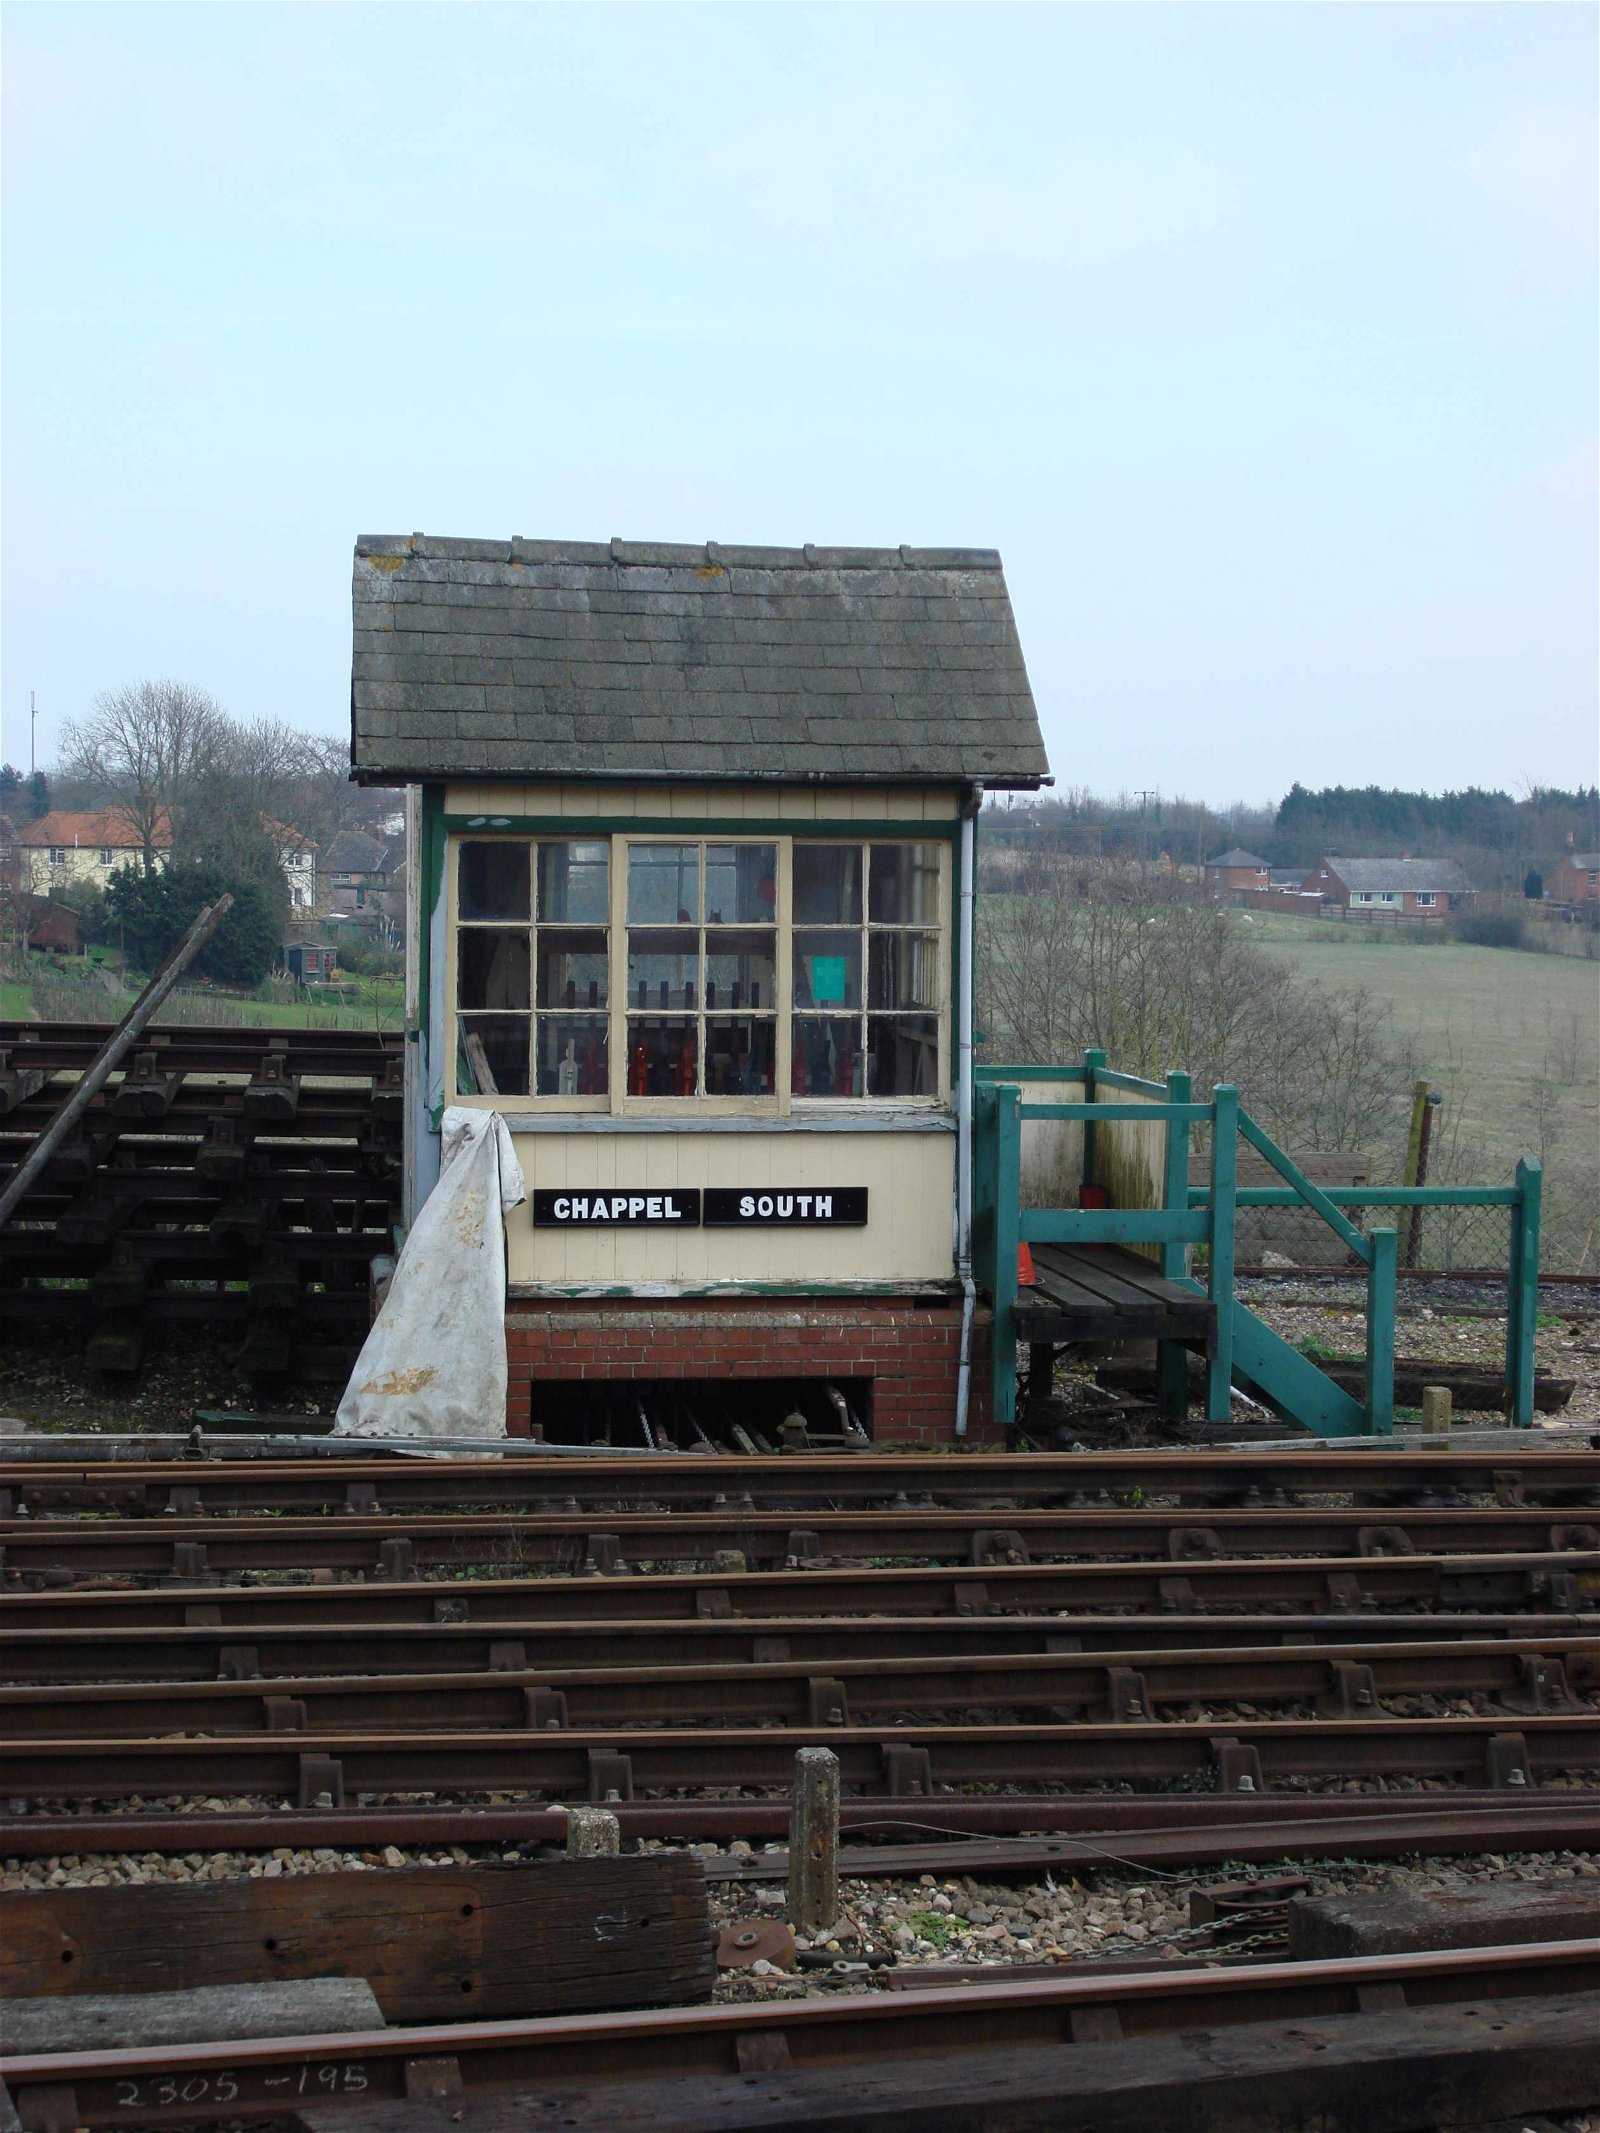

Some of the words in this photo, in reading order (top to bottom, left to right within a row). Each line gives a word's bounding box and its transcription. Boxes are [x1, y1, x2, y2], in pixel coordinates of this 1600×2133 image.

[553, 1196, 682, 1219] CHAPPEL
[739, 1195, 833, 1218] SOUTH
[116, 2072, 239, 2107] 2305
